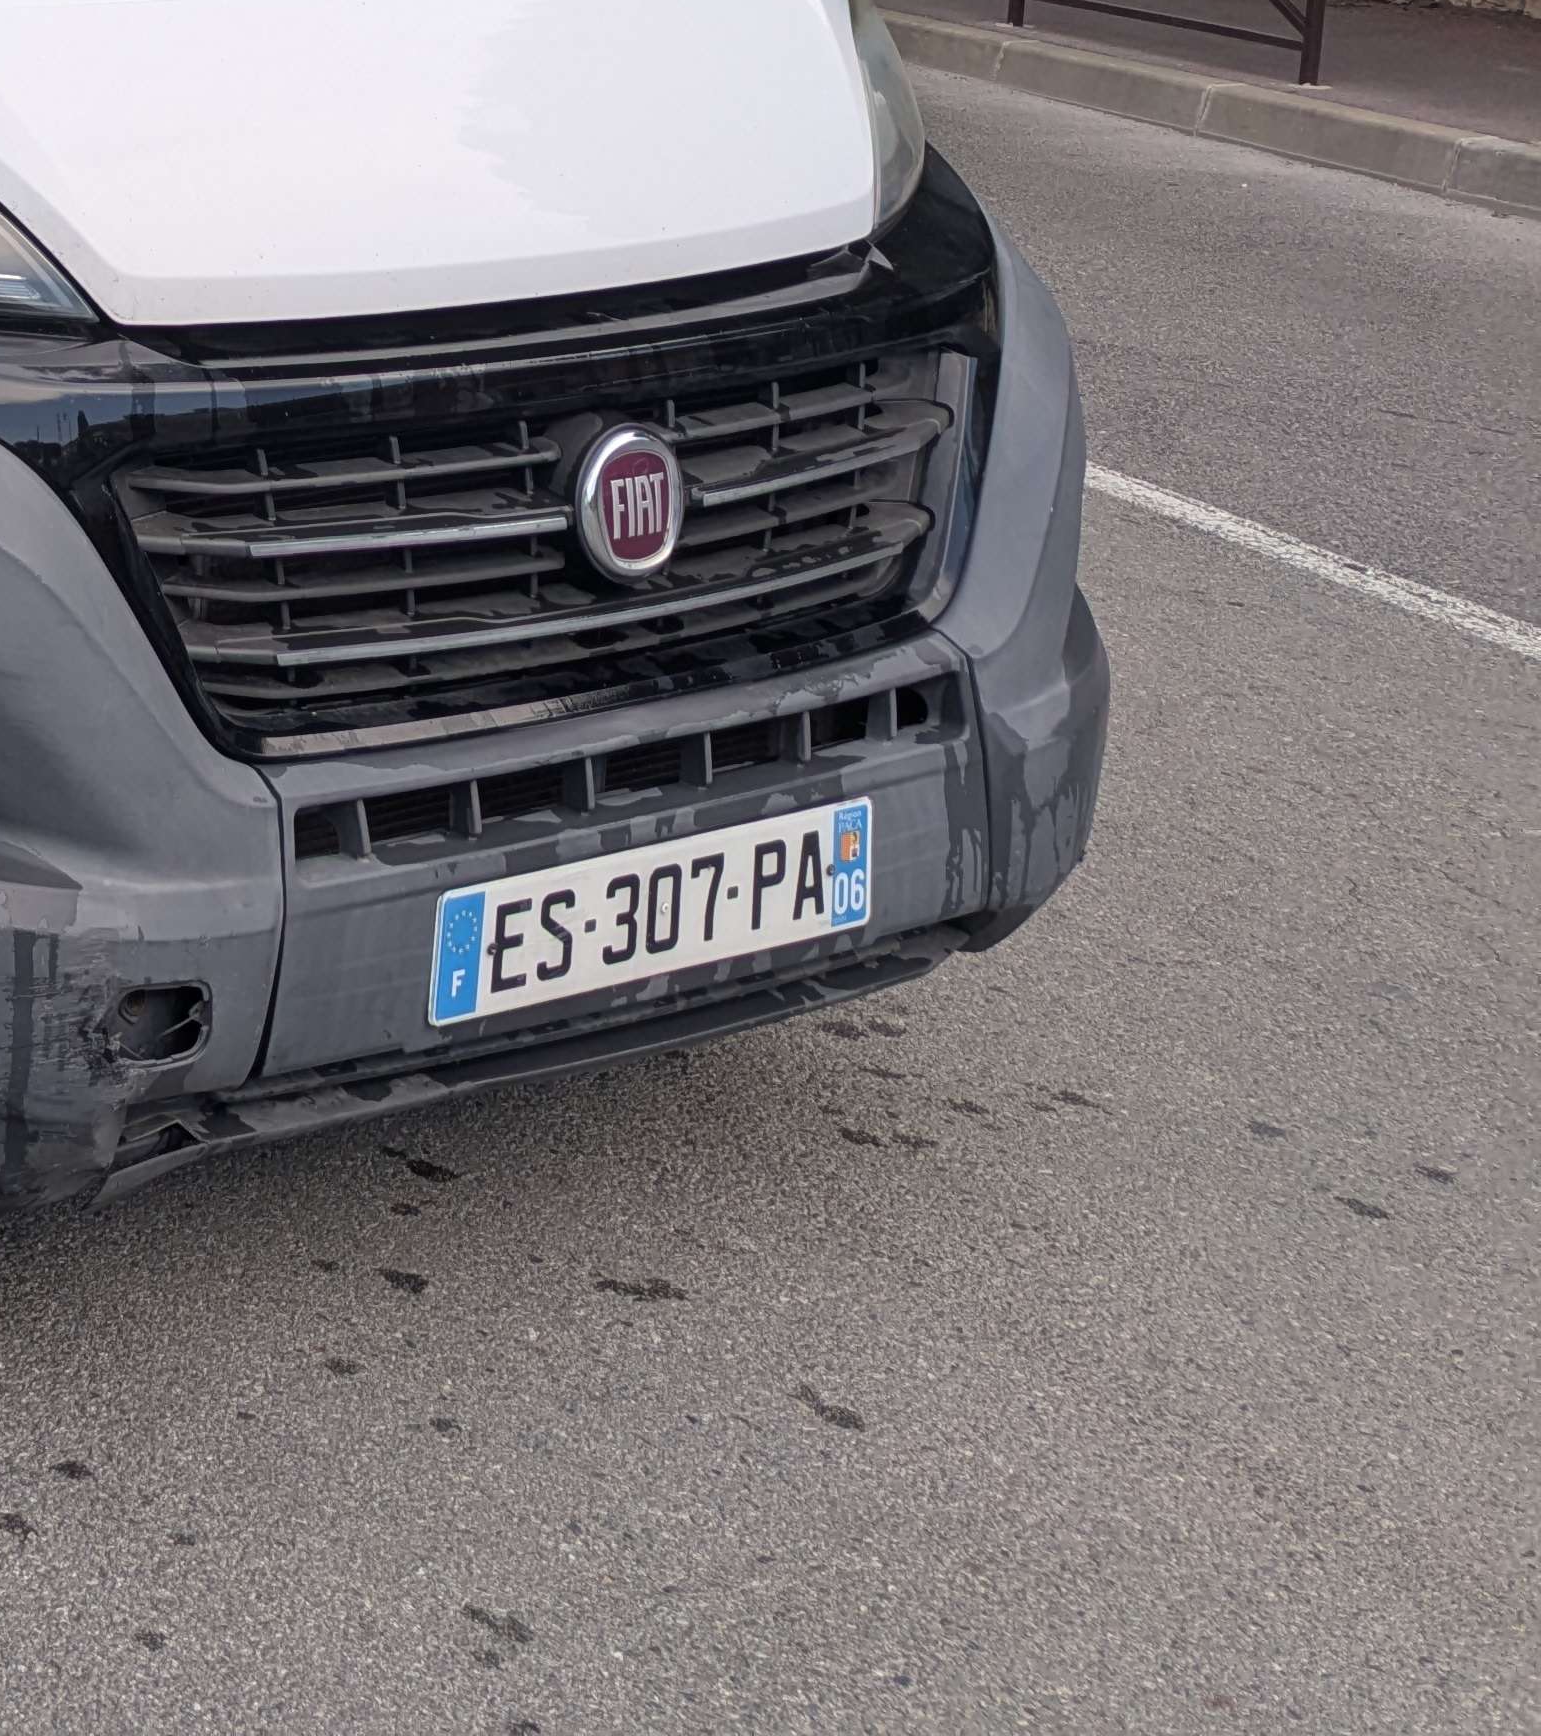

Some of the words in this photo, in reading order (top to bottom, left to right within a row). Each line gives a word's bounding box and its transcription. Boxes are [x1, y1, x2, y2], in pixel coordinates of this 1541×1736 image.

[610, 472, 664, 540] FIAT
[834, 868, 865, 916] 06
[450, 969, 465, 998] F
